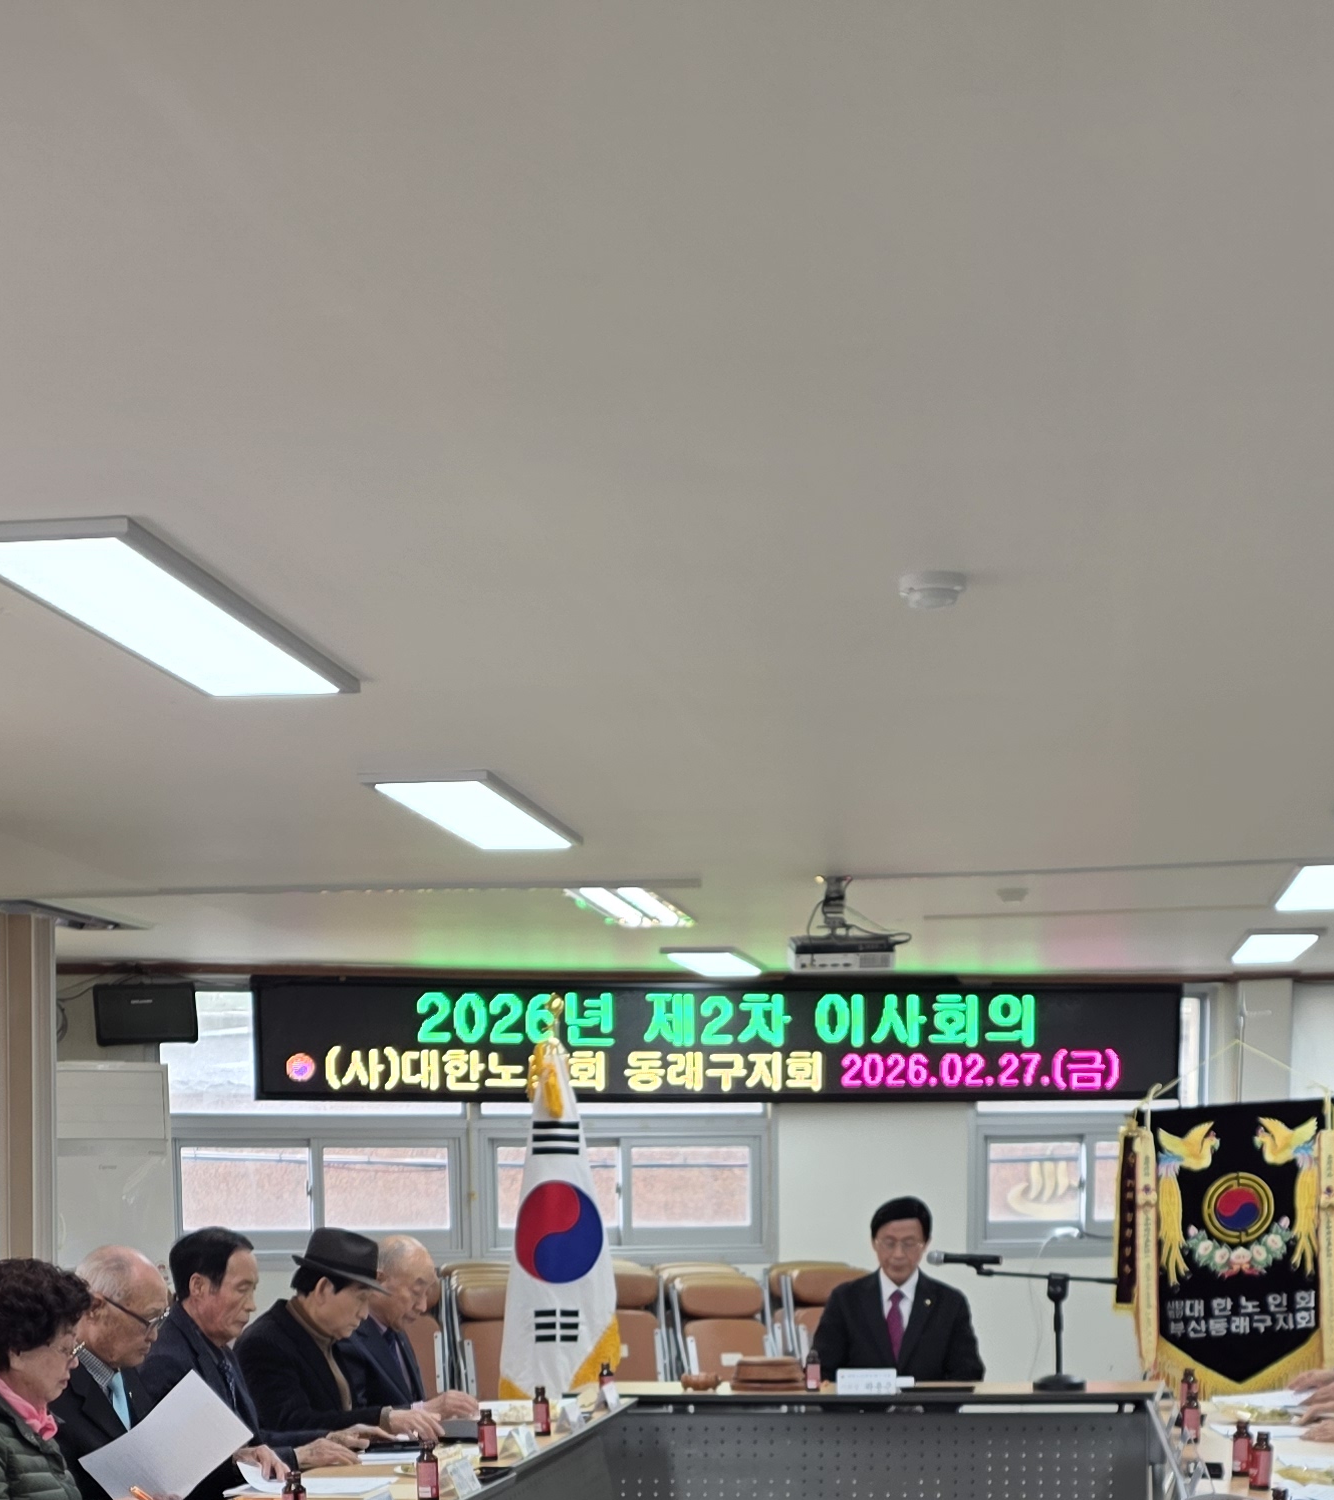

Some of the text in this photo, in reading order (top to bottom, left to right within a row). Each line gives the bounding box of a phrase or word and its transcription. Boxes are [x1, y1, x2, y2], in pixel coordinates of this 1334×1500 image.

[416, 991, 1037, 1048] 2026년 제2차 이사회의
[324, 1045, 1120, 1092] (사)대한노회 동래구지회 2026.02.27.(금)
